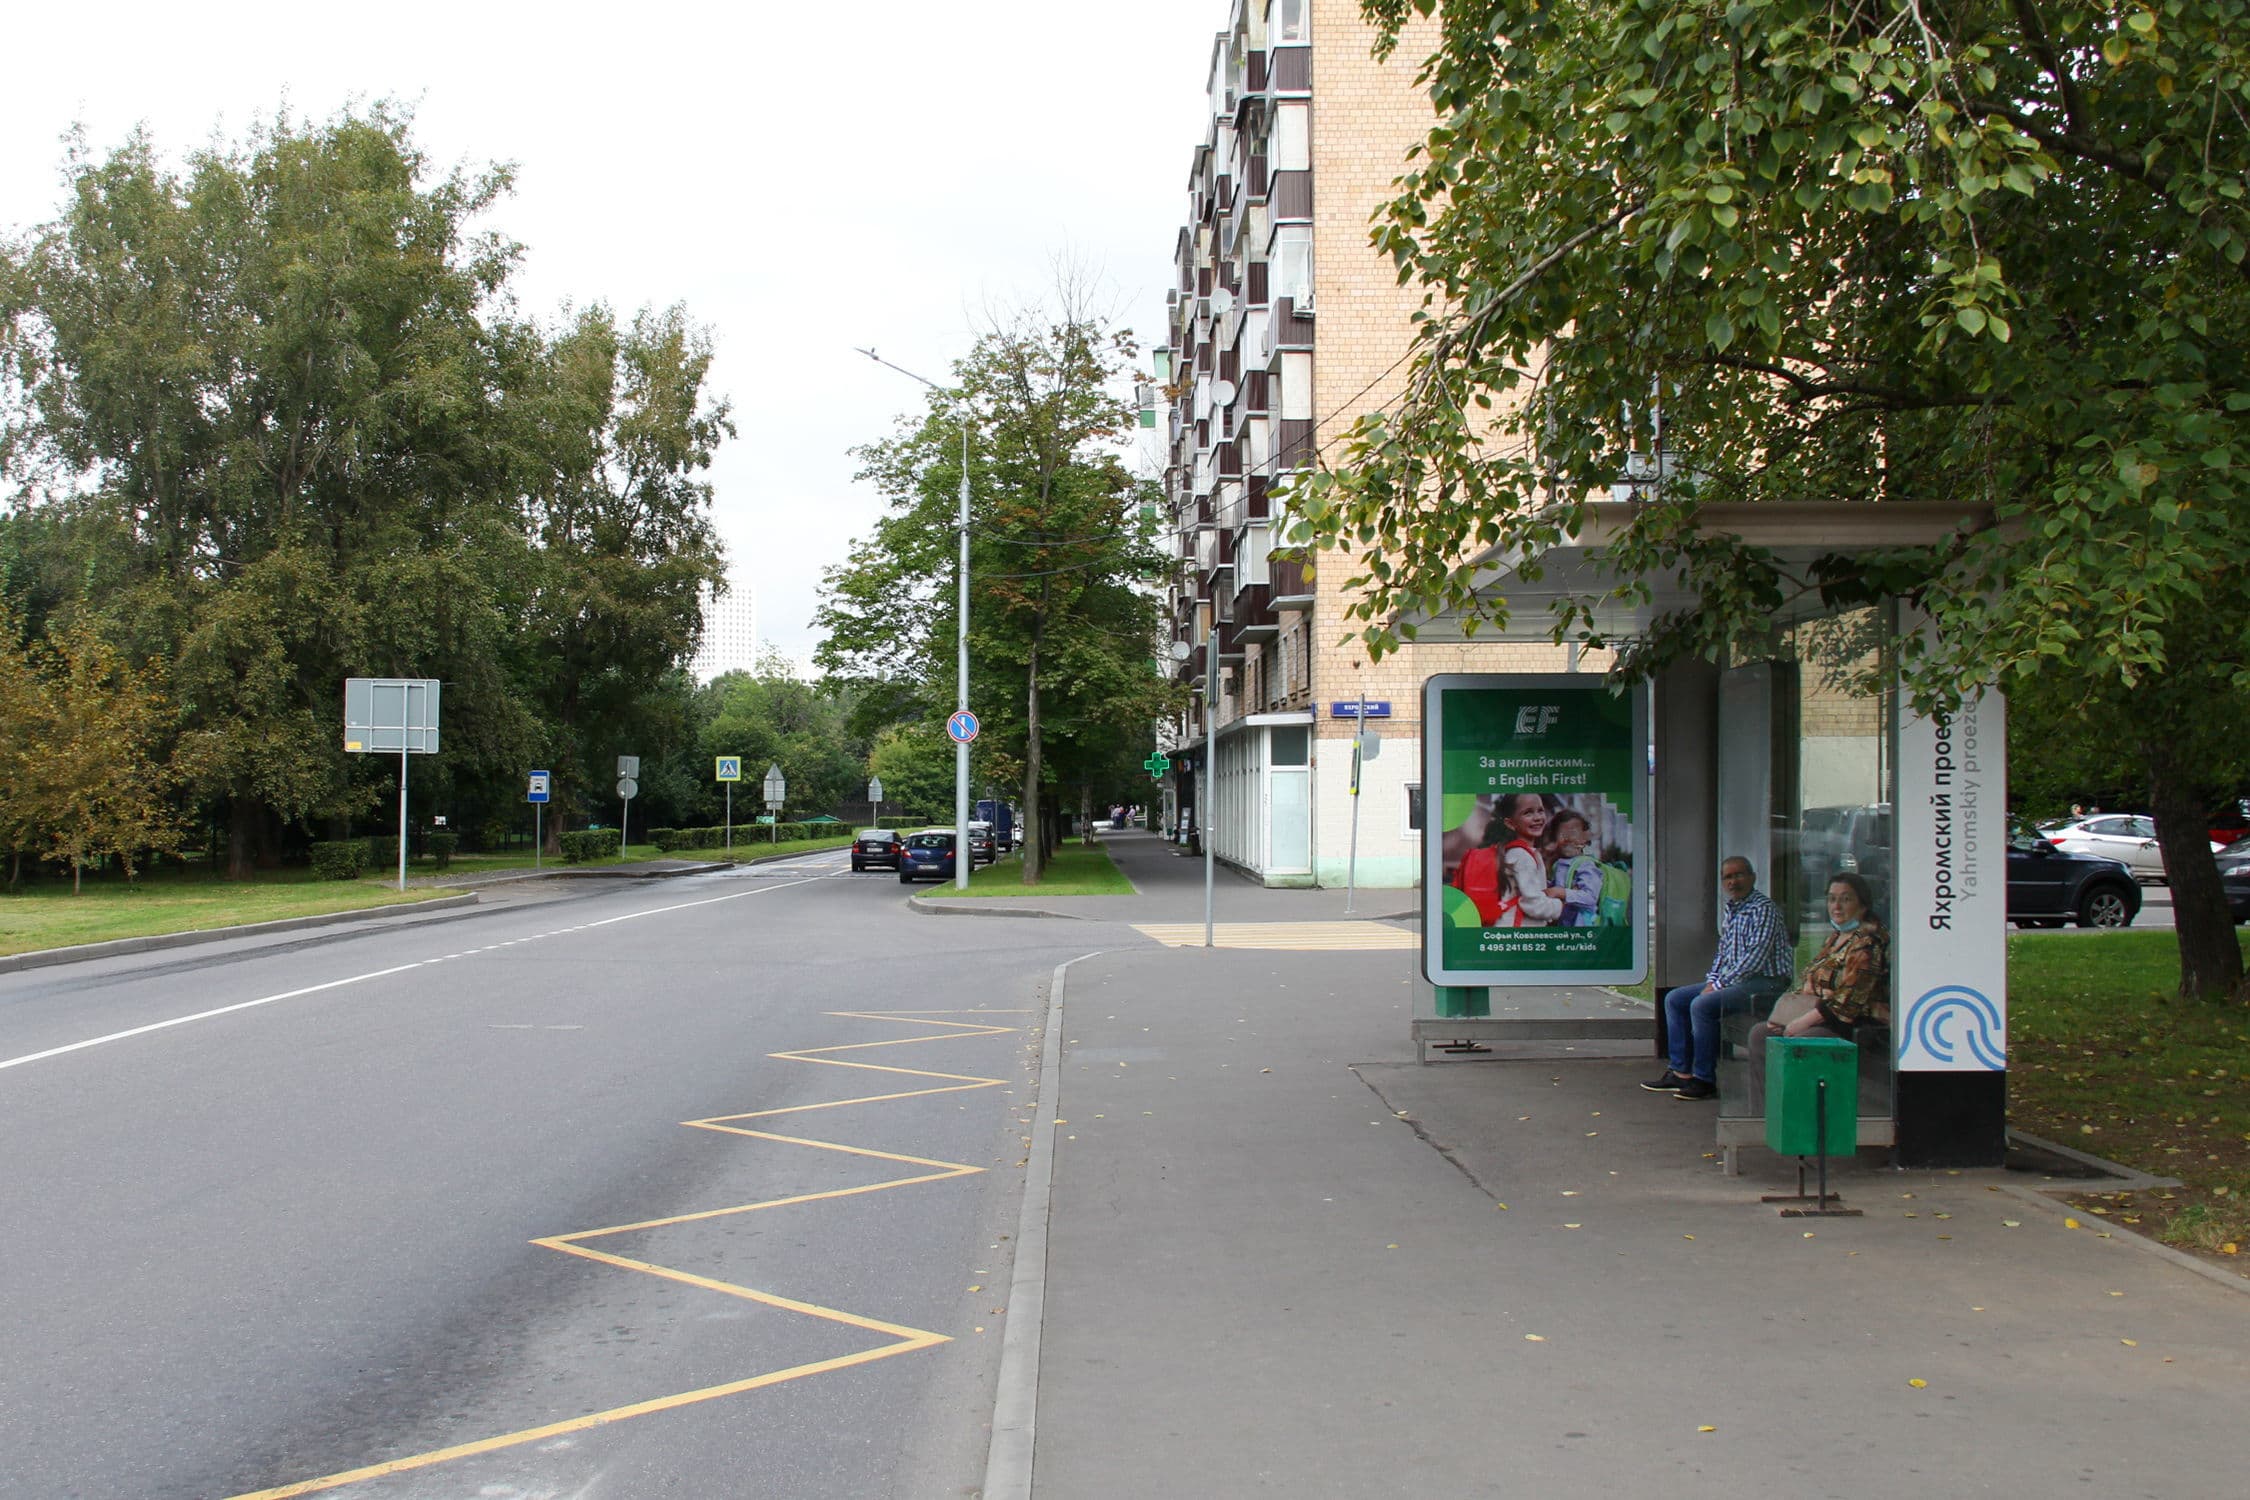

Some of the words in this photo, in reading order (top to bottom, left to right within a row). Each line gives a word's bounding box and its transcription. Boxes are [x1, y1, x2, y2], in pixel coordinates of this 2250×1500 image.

[1513, 706, 1560, 733] EF
[1961, 701, 1981, 773] proezd
[1479, 756, 1496, 767] За
[1499, 755, 1595, 767] английским...
[1488, 776, 1496, 785] в
[1500, 773, 1548, 788] English
[1552, 773, 1587, 784] First!
[1960, 779, 1981, 902] Yahromskiy
[1929, 794, 1956, 931] Яхромский
[1483, 931, 1512, 940] Софьи
[1513, 931, 1569, 939] Ковалевской
[1487, 943, 1504, 951] 495
[1506, 943, 1521, 951] 241
[1535, 943, 1547, 951] 22
[1556, 943, 1597, 951] ef.ru/kids
